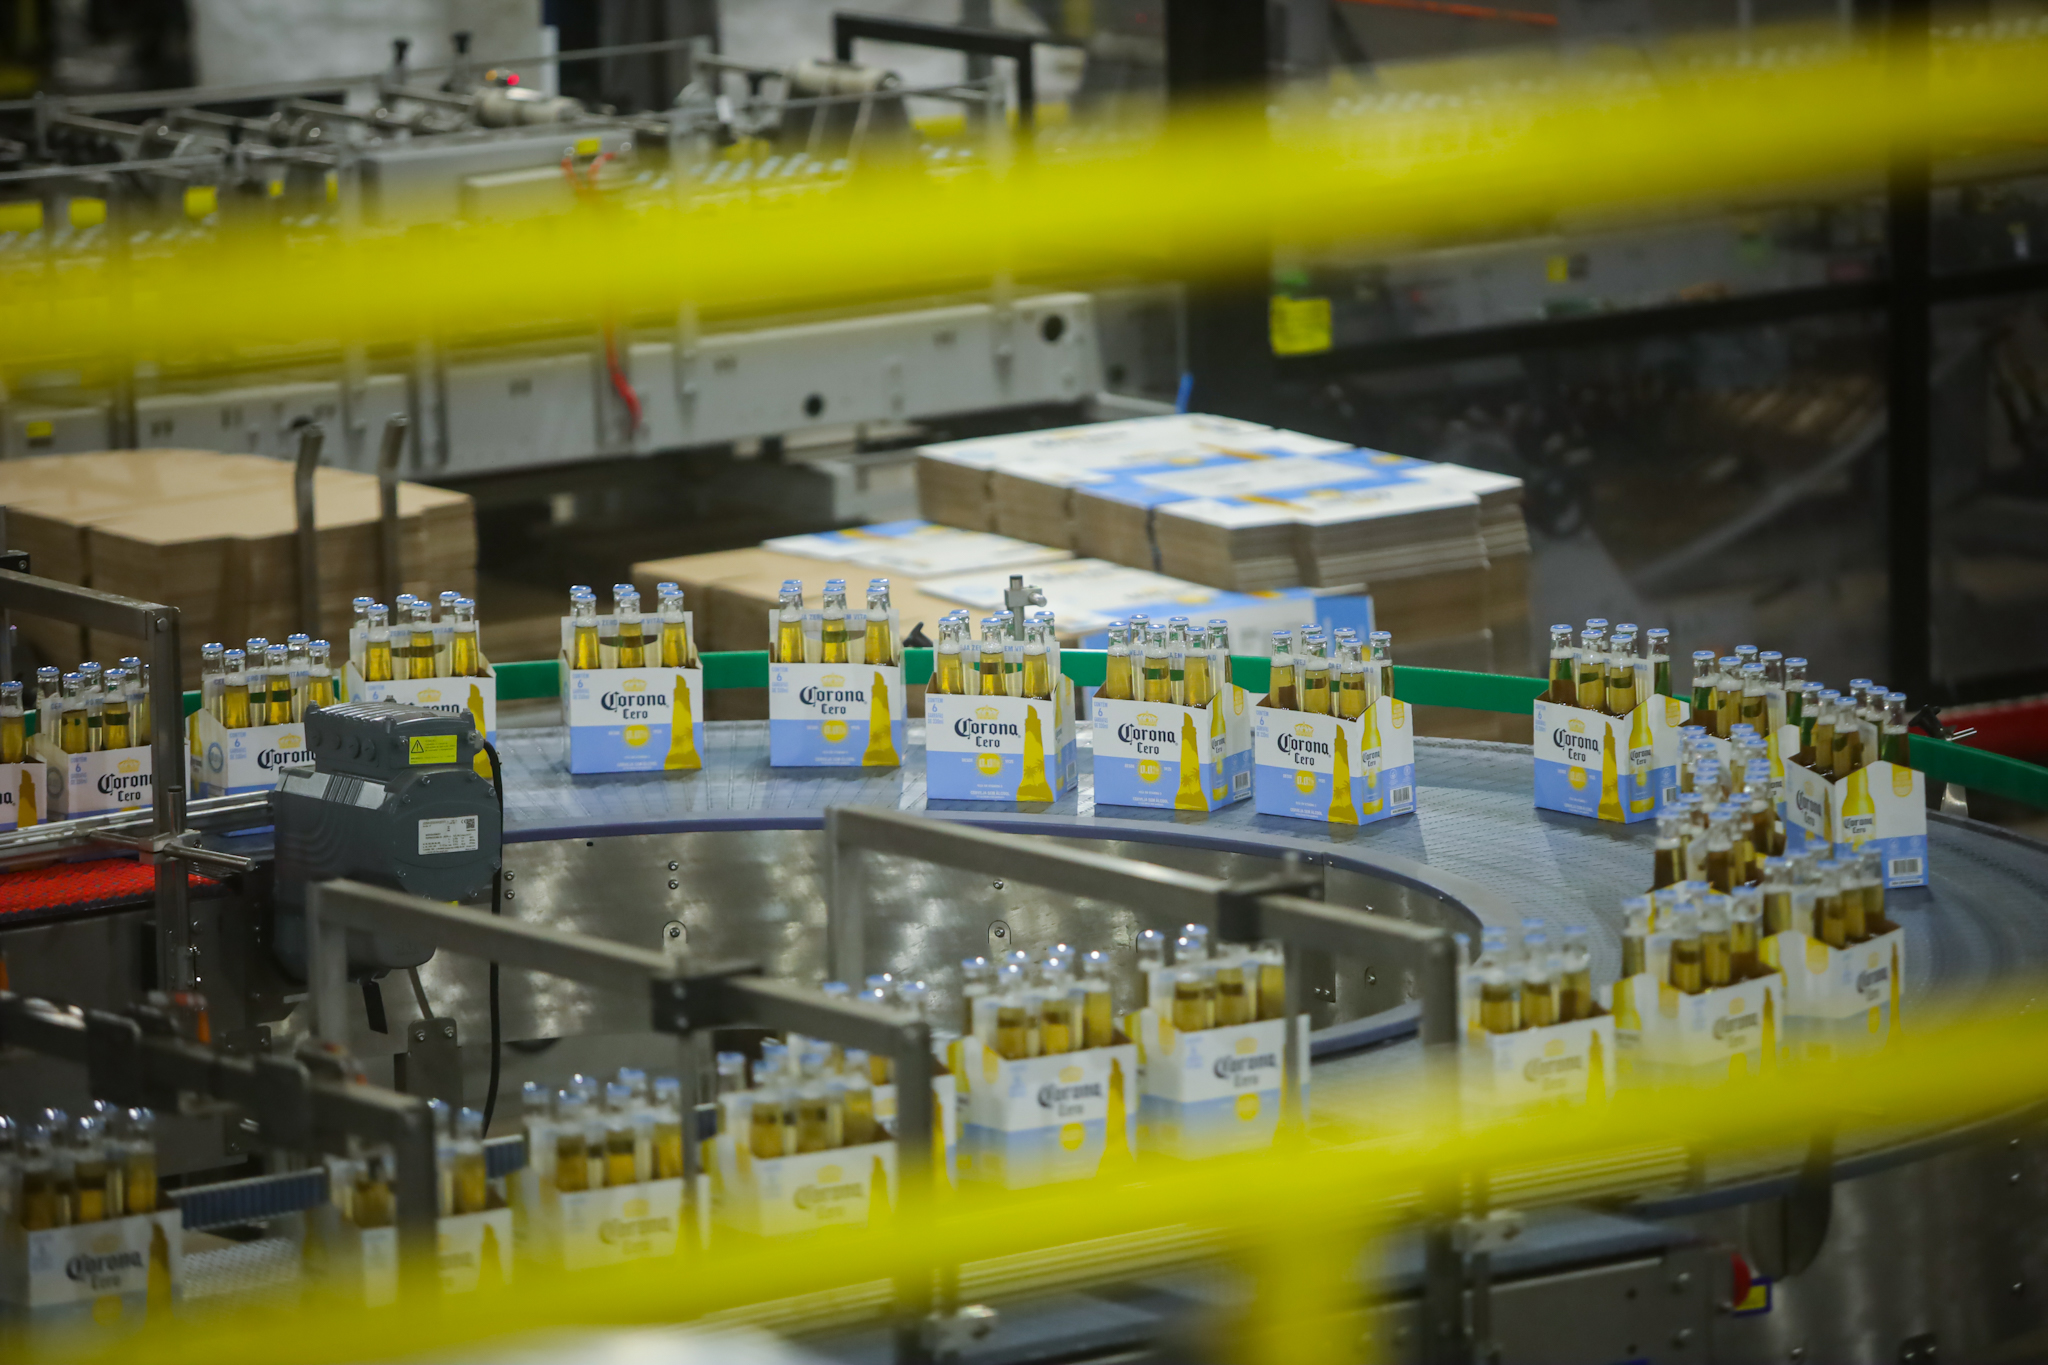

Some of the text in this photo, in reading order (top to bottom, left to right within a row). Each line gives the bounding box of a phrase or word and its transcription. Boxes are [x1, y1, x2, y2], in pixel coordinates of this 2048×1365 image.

[776, 673, 782, 681] 6
[577, 680, 583, 688] 6
[373, 691, 379, 700] 6
[601, 691, 667, 712] Corona
[799, 685, 865, 707] Corona
[821, 703, 846, 715] Cero
[932, 703, 938, 712] 6
[1097, 708, 1103, 717] 6
[623, 709, 648, 719] Cero
[1537, 711, 1543, 720] 6
[1259, 717, 1265, 726] 6
[954, 717, 1018, 739] Corona
[1118, 723, 1176, 745] Corona
[234, 739, 240, 748] 6
[975, 736, 1000, 748] Cero
[1277, 733, 1330, 755] Corona
[1553, 728, 1599, 752] Corona
[1137, 742, 1160, 755] Cero
[1294, 752, 1315, 766] Cero
[1362, 750, 1381, 763] Corona
[1568, 748, 1586, 762] Cero
[1630, 749, 1651, 761] Corona
[75, 763, 82, 773] 6
[1636, 758, 1647, 766] Cero
[98, 773, 152, 796] Coron
[118, 790, 141, 802] Cero
[1796, 790, 1822, 817] Corona
[1844, 817, 1873, 829] Corona
[1852, 826, 1866, 834] Cero
[1038, 1083, 1102, 1108] Corona
